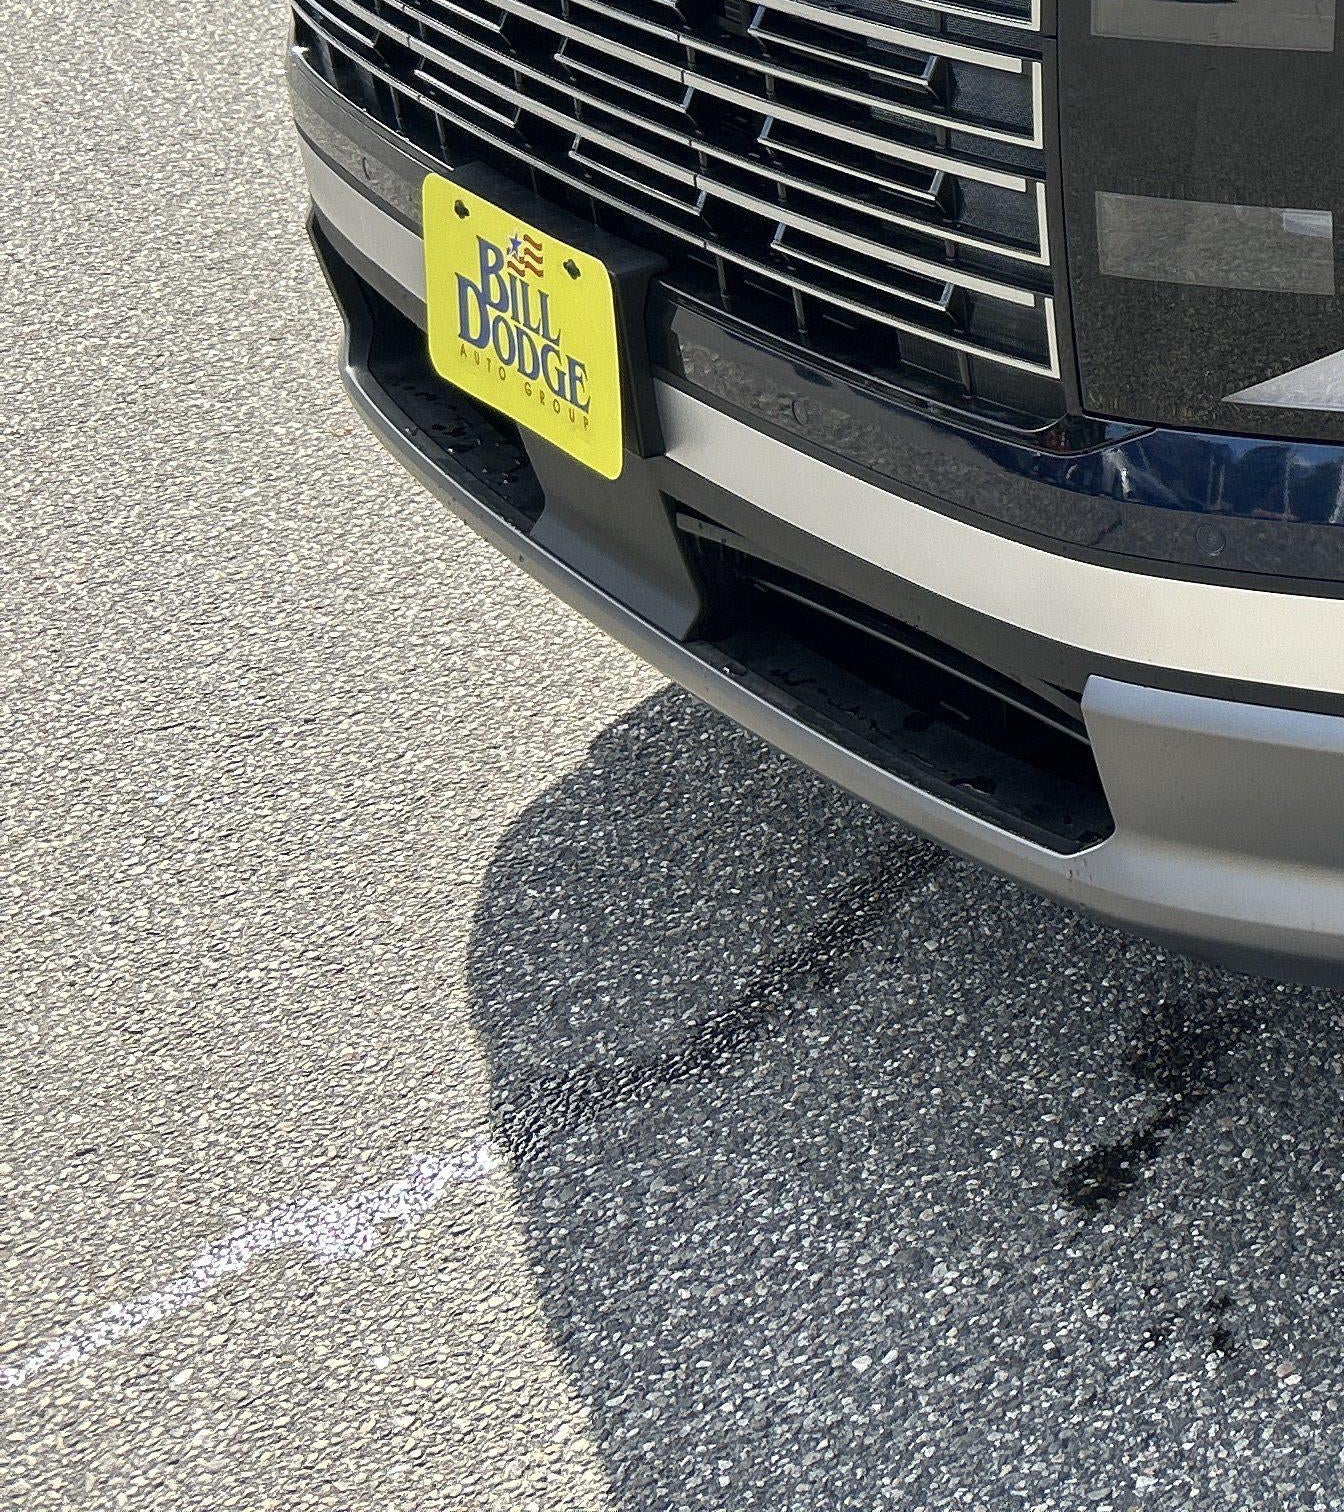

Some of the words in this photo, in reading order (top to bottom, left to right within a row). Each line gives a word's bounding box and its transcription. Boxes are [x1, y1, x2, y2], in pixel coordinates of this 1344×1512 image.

[455, 272, 592, 414] DODGE
[476, 235, 562, 347] BILL
[459, 342, 507, 381] AUTO
[524, 380, 590, 432] GROUP
